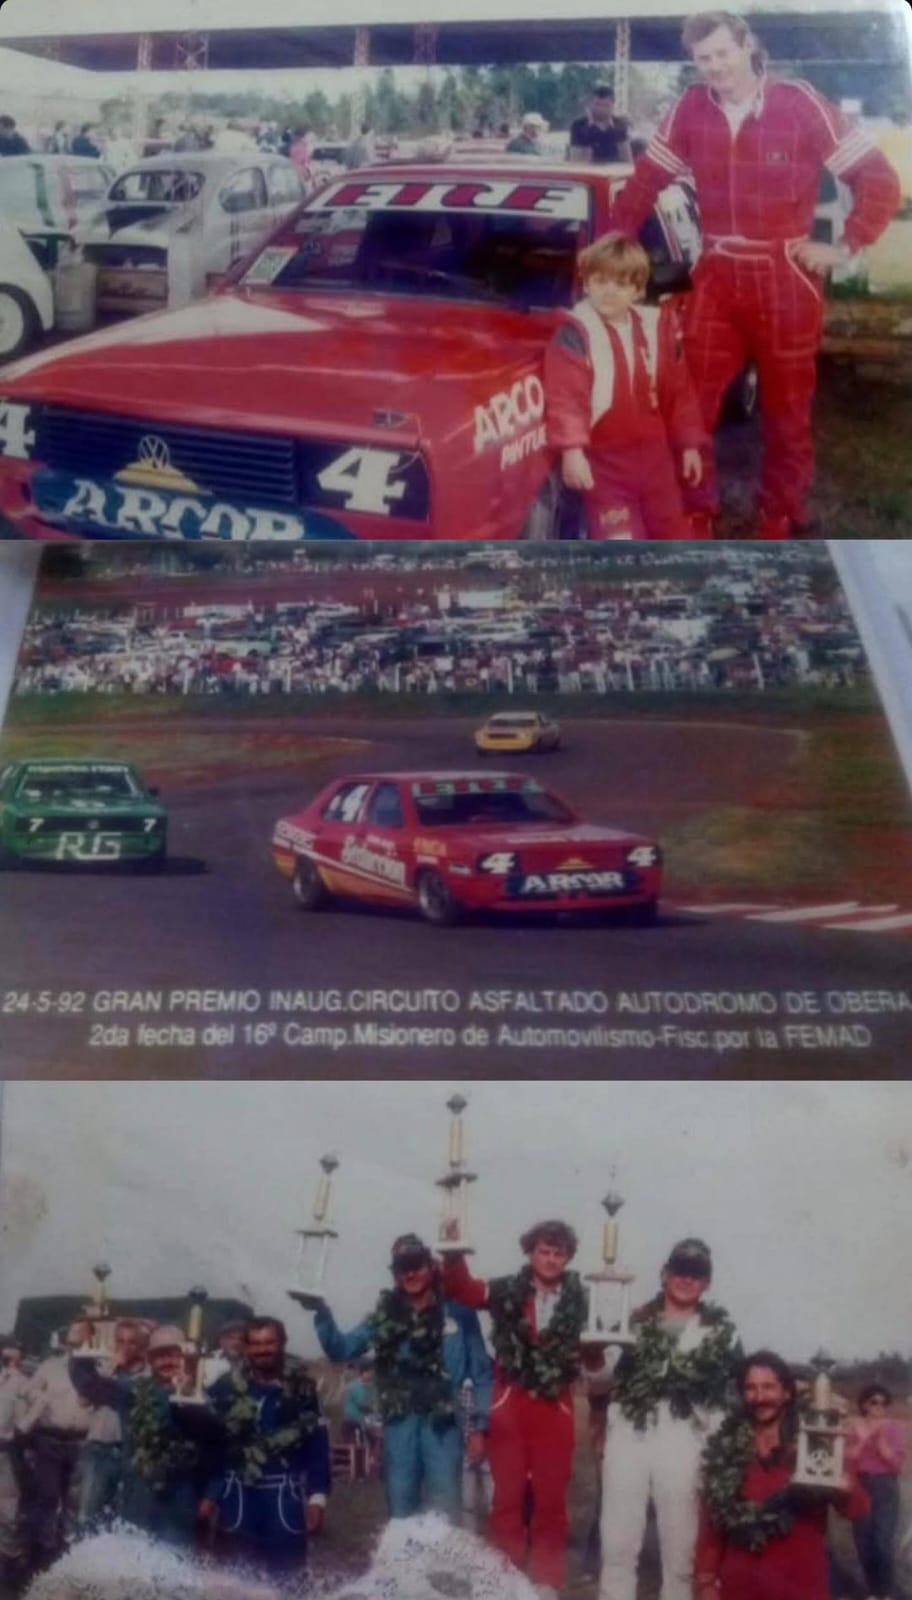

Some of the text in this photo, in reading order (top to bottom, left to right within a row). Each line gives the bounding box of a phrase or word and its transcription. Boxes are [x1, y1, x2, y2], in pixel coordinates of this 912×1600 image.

[316, 446, 407, 515] 4
[29, 817, 44, 833] 7
[144, 817, 157, 832] 7
[55, 831, 122, 860] RG
[627, 846, 656, 867] 4
[482, 852, 516, 875] 4
